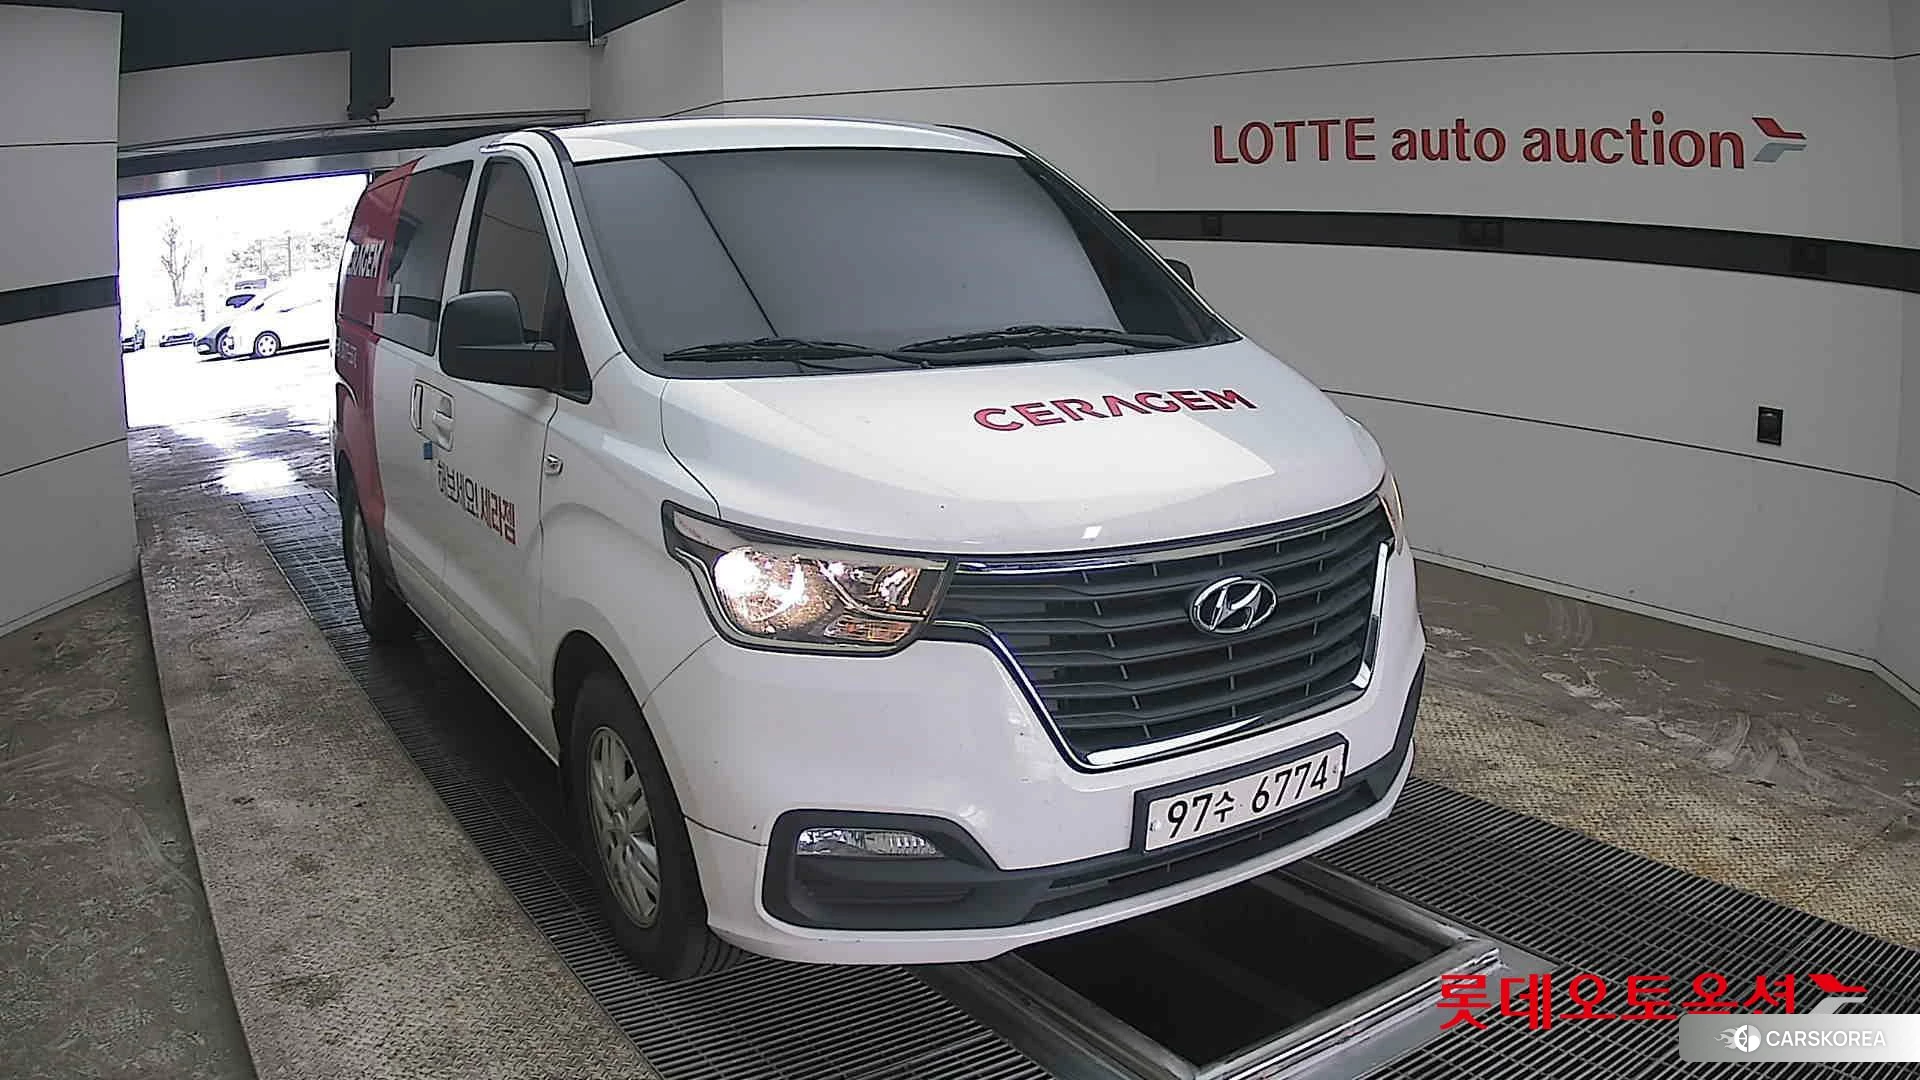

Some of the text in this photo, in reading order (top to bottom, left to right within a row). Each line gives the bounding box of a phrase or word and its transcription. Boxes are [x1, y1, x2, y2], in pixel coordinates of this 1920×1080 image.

[1212, 110, 1745, 169] LOTTE auto auction
[973, 389, 1257, 432] CERAGEM
[1167, 755, 1328, 839] 97수 6774
